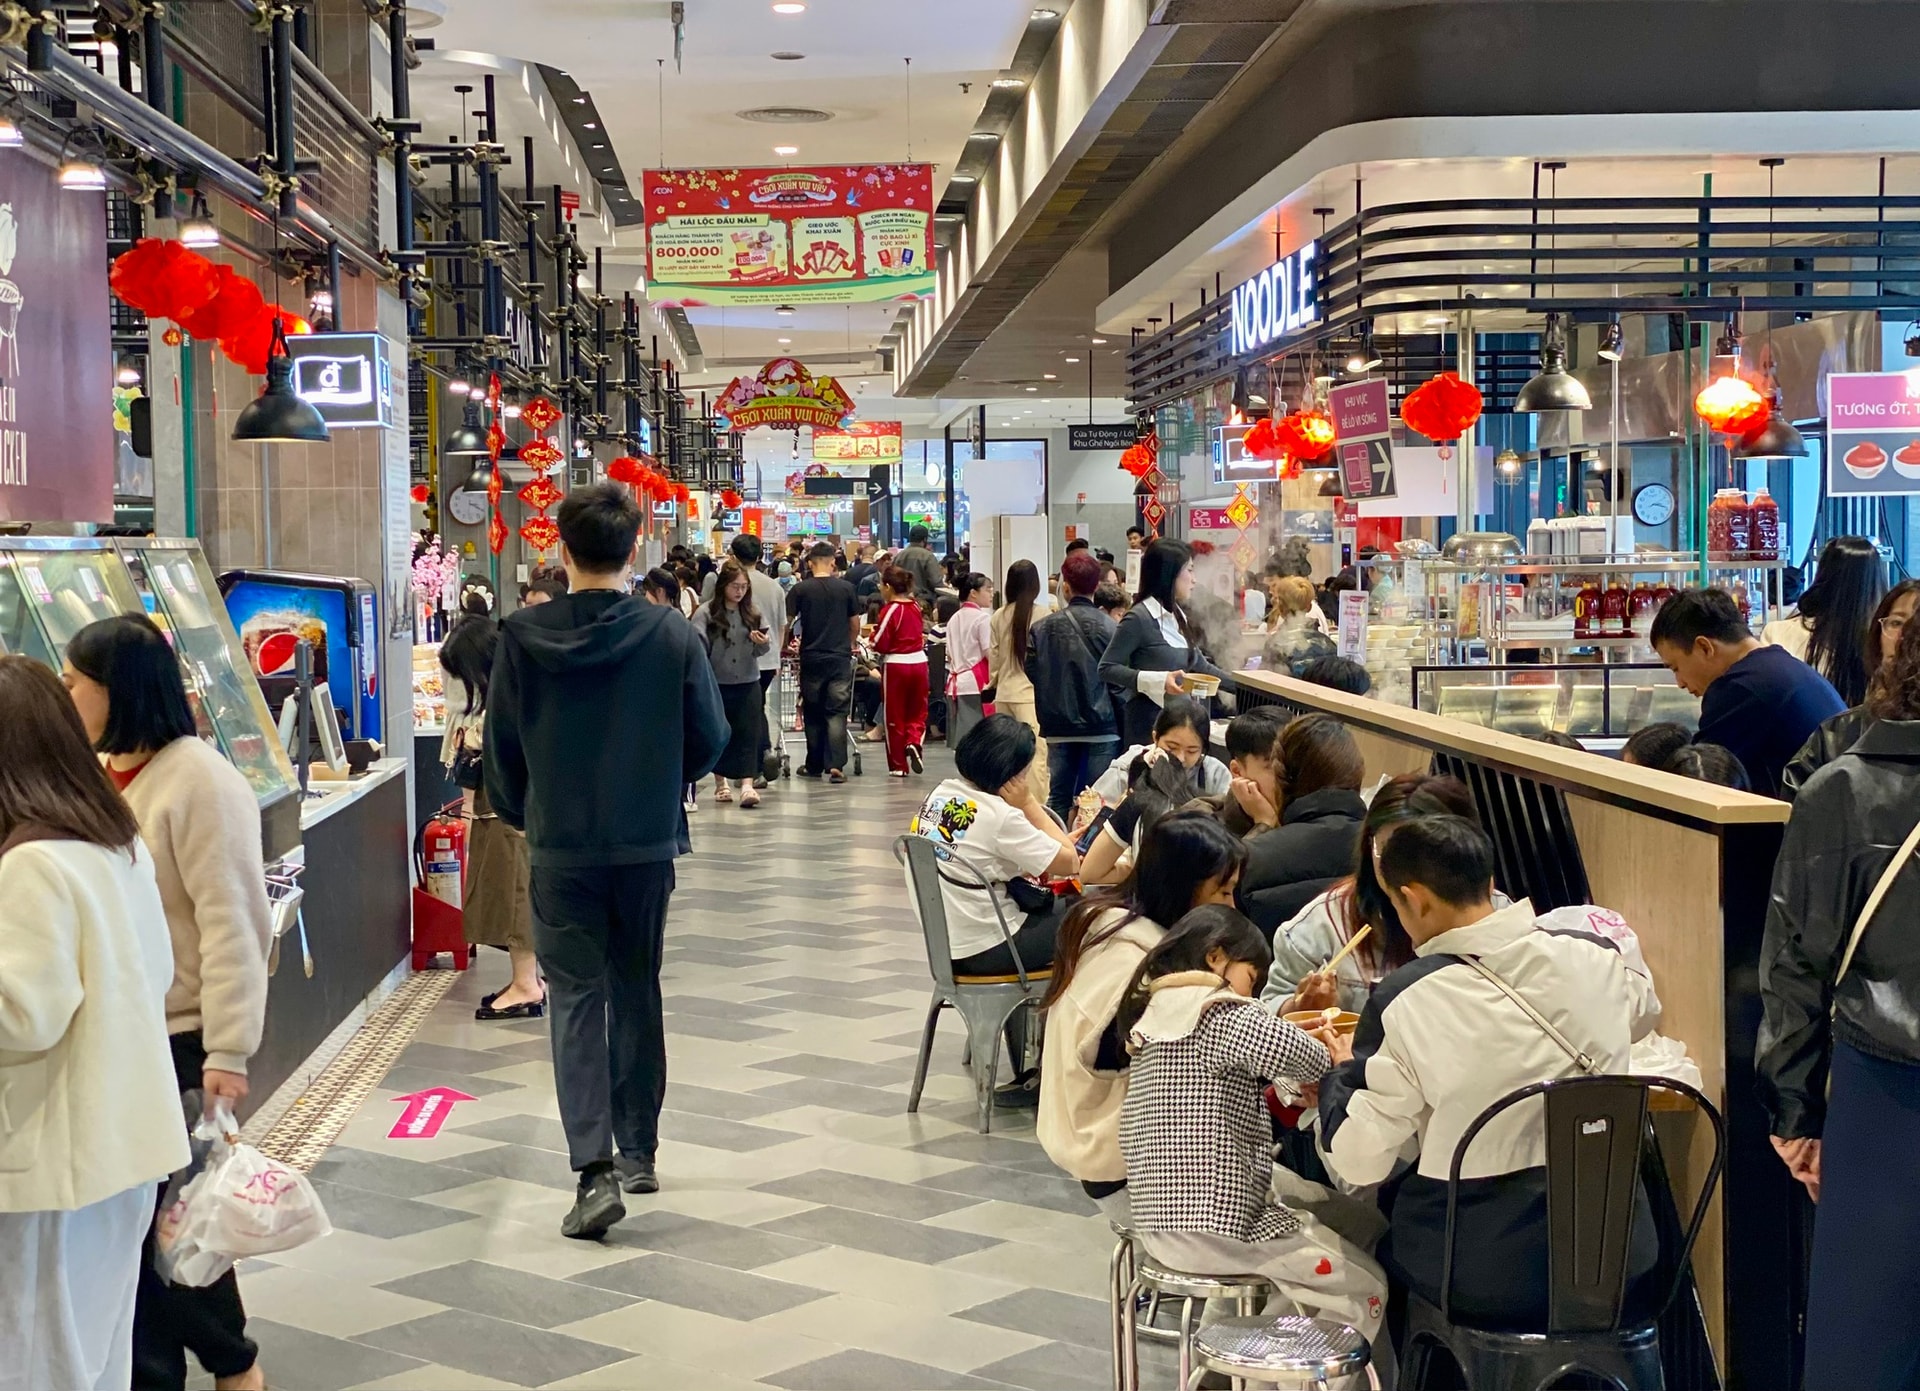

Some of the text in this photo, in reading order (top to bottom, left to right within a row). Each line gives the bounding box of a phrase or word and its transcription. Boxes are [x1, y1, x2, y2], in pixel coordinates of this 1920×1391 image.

[698, 218, 714, 227] LỘC
[716, 216, 735, 225] ĐẦU
[737, 216, 757, 224] NĂM
[1232, 239, 1315, 356] NOODLE
[1344, 392, 1368, 408] KHU VỰC
[762, 405, 792, 421] XUÂN
[795, 408, 812, 421] VUI
[1835, 403, 1886, 415] TƯƠNG
[1889, 401, 1911, 416] ỚT,
[1361, 411, 1377, 426] SÓNG
[1073, 439, 1088, 447] Khu
